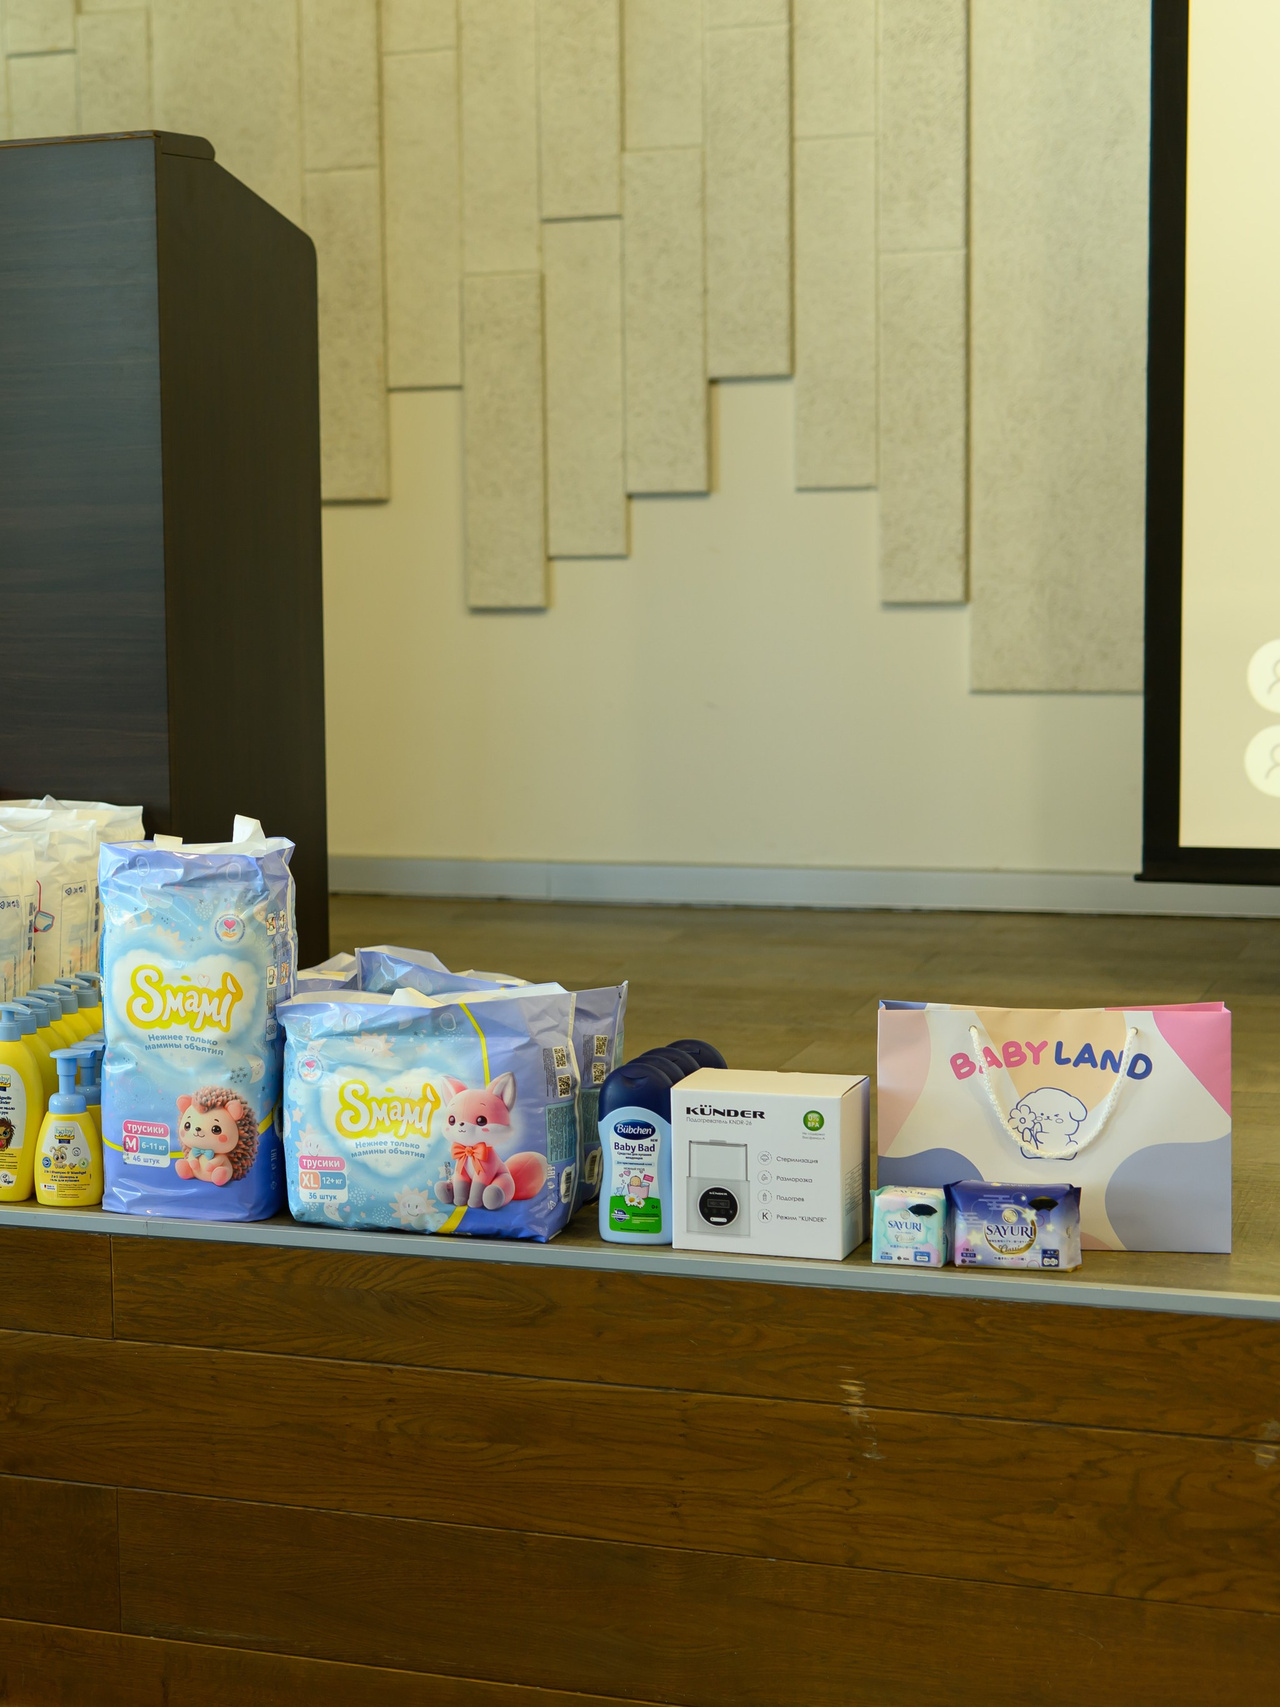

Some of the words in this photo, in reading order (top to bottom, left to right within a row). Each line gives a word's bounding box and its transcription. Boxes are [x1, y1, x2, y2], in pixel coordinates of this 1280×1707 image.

[147, 1033, 183, 1042] Нежнее
[185, 1035, 218, 1046] только
[144, 1042, 182, 1052] мамины
[184, 1042, 224, 1056] объятия
[949, 1040, 1048, 1080] BABY
[1054, 1040, 1153, 1080] LAND
[686, 1104, 766, 1119] KÜNDER
[686, 1116, 728, 1126] Подогреватель
[728, 1118, 752, 1126] KNDR-26
[126, 1123, 165, 1135] трусики
[615, 1123, 653, 1135] Bübchen
[125, 1136, 137, 1151] M
[141, 1141, 158, 1150] 6-11
[355, 1140, 388, 1149] Нежнее
[390, 1140, 420, 1150] только
[614, 1142, 637, 1154] Baby
[637, 1143, 656, 1153] Bad
[351, 1148, 387, 1158] мамины
[388, 1147, 426, 1159] объятия
[132, 1155, 141, 1163] 46
[143, 1157, 160, 1166] штук
[302, 1158, 341, 1169] трусики
[776, 1156, 819, 1164] Стерилизация
[301, 1173, 318, 1188] XL
[321, 1176, 334, 1184] 12+
[776, 1175, 813, 1183] Разморозка
[776, 1195, 805, 1203] Подогрев
[888, 1220, 922, 1232] SAYURI
[986, 1224, 1033, 1238] SAYURI
